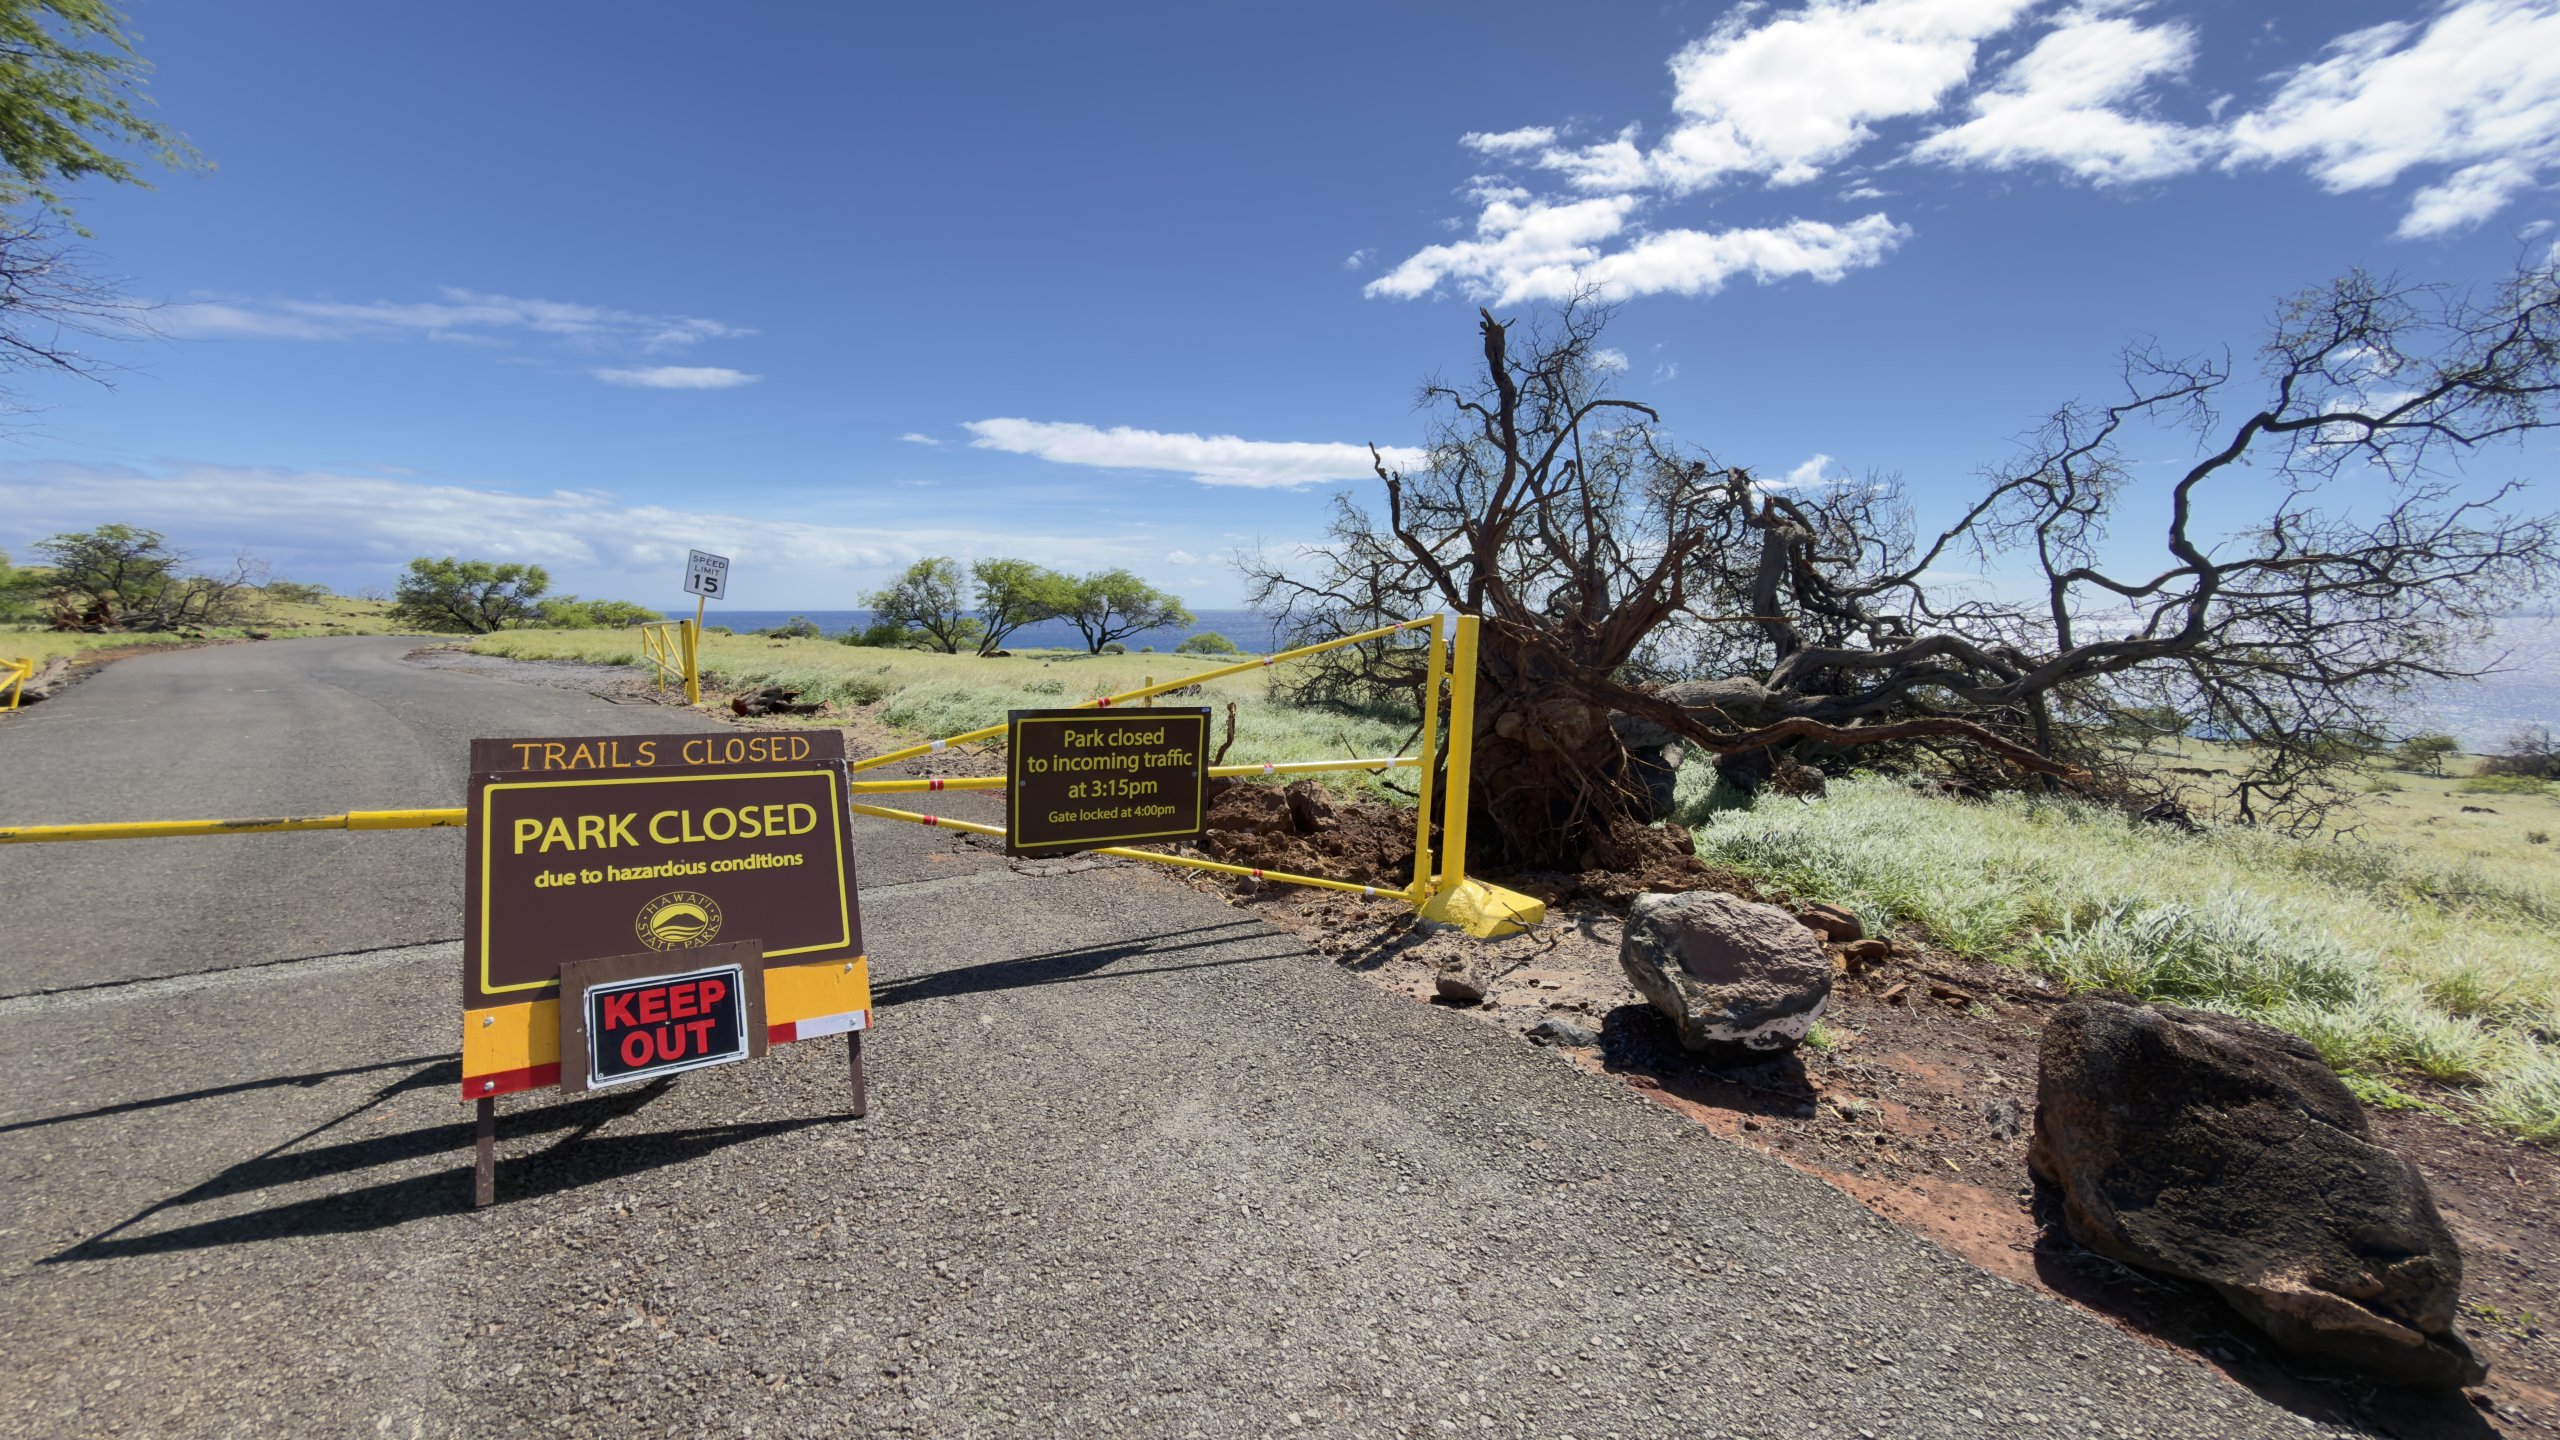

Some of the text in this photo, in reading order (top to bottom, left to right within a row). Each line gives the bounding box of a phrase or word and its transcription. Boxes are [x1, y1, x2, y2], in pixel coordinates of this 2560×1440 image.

[693, 555, 725, 569] SPEED
[694, 565, 720, 576] LIMIT
[694, 574, 718, 593] 15
[1065, 727, 1165, 748] Park closed
[512, 737, 810, 769] TRAILS CLOSED
[1027, 749, 1193, 773] to incoming traffic
[1069, 779, 1158, 800] at 3:15pm
[1048, 805, 1176, 823] Gate locked at 4:00pm
[514, 803, 817, 854] PARK CLOSED
[534, 851, 803, 888] due to hazardous conditions
[684, 914, 720, 949] PARKS
[604, 980, 726, 1031] KEEP
[620, 1019, 716, 1067] OUT
